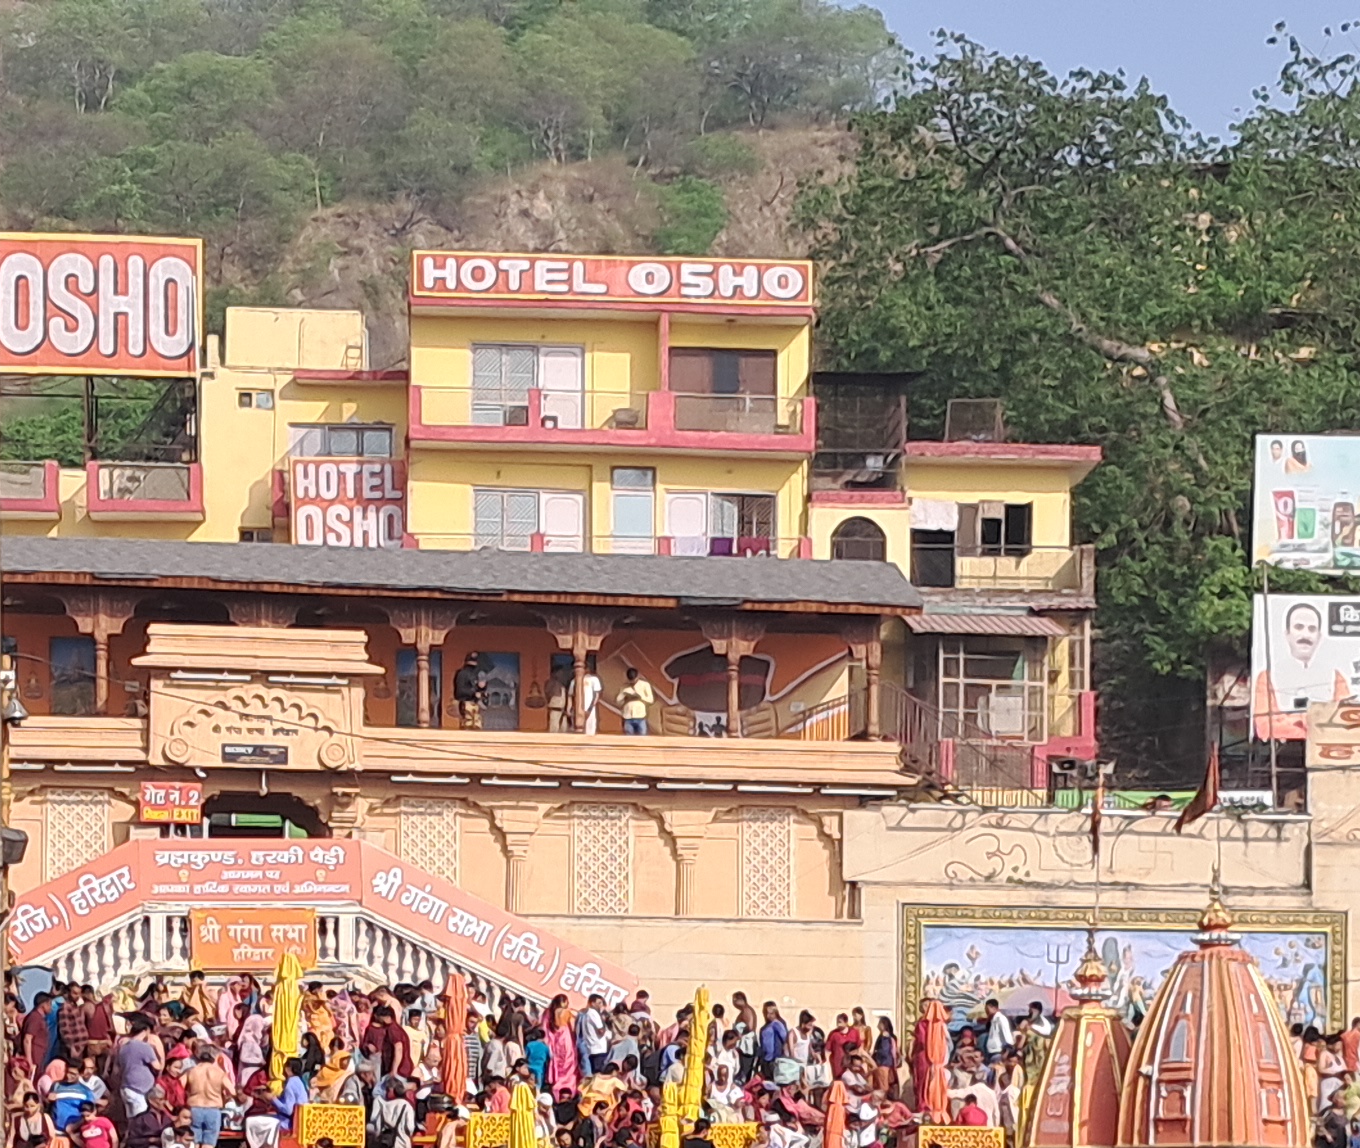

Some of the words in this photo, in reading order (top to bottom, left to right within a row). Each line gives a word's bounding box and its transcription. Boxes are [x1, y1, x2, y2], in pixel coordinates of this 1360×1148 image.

[422, 256, 607, 294] HOTEL
[296, 462, 403, 499] HOTEL
[296, 504, 403, 549] OSHO
[188, 790, 199, 806] 2
[66, 865, 137, 916] हरिद्वार
[371, 867, 402, 901] श्री
[401, 884, 448, 924] गंगा
[447, 906, 494, 946] सभा
[198, 917, 221, 944] श्री
[227, 919, 263, 943] गंगा
[270, 923, 308, 944] सभा
